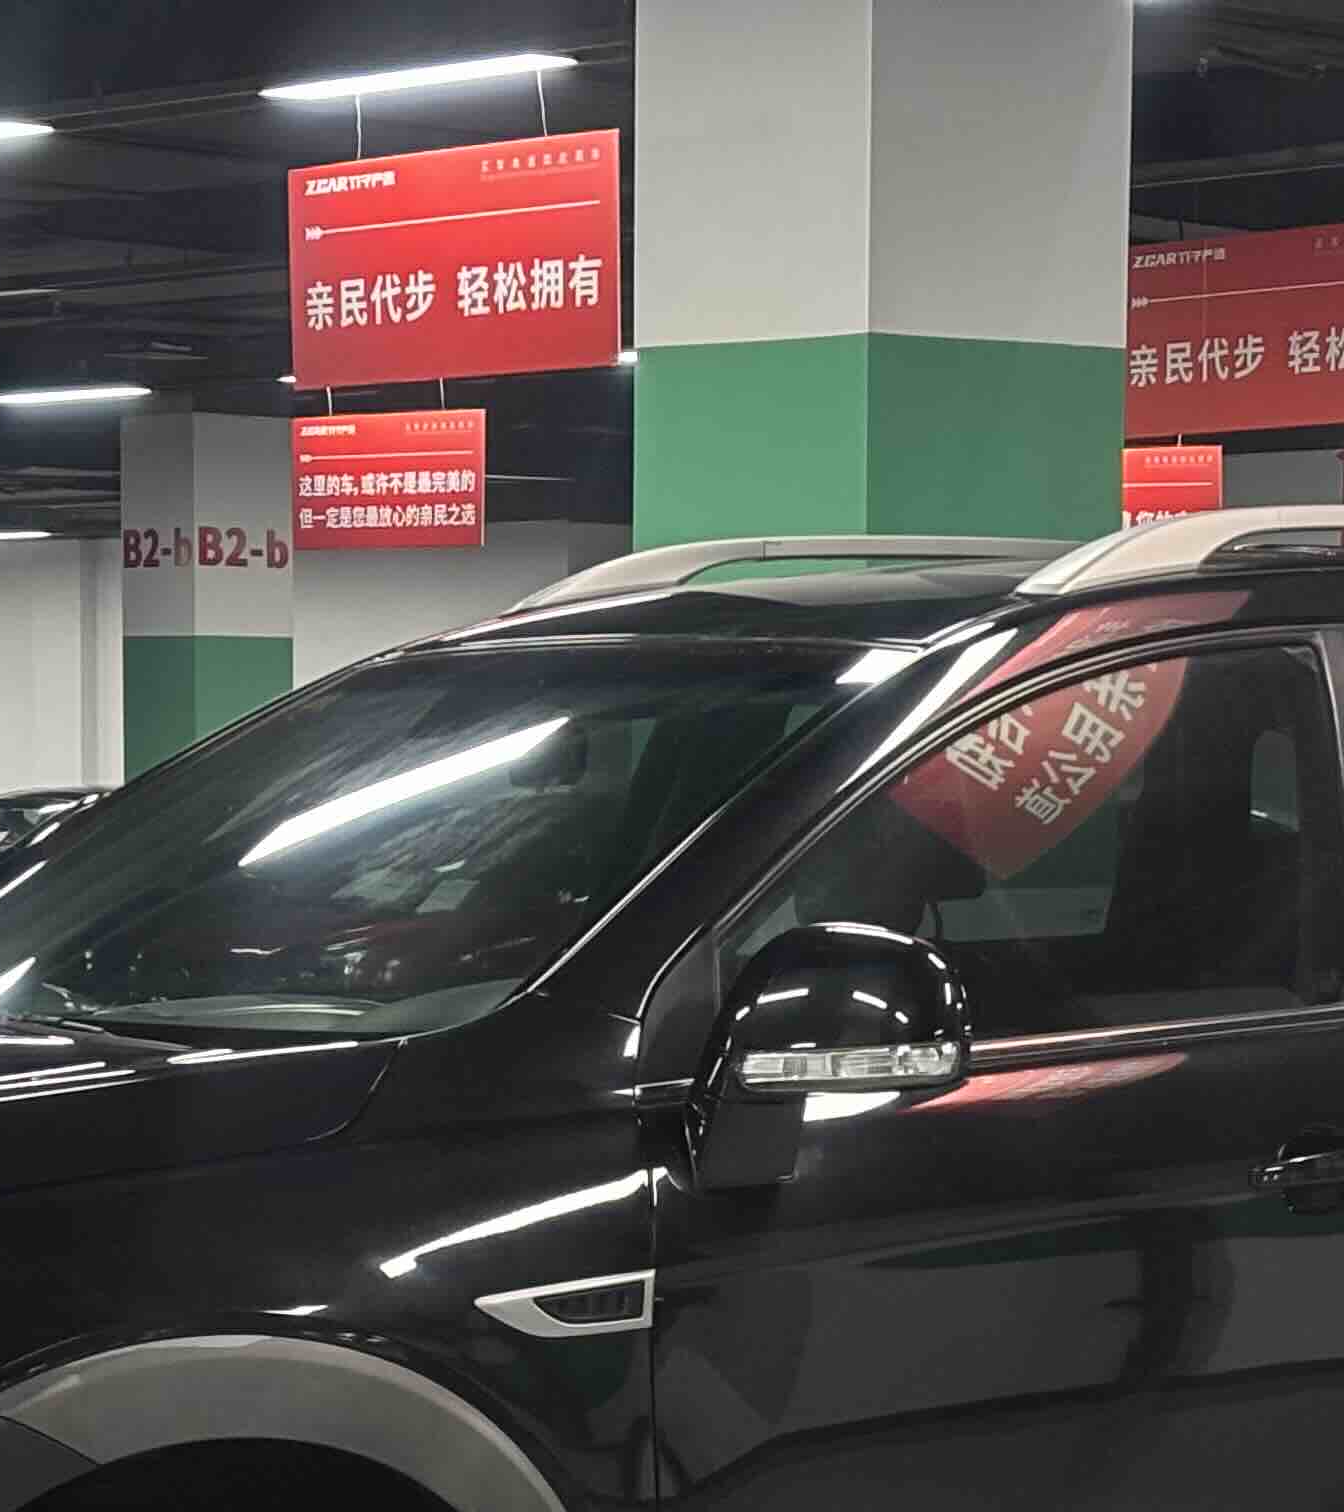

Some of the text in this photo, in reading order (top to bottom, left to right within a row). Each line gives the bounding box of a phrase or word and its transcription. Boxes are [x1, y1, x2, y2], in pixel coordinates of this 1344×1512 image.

[1132, 252, 1176, 269] ZCAR
[305, 253, 602, 331] 亲民代步 轻松拥有
[1128, 333, 1264, 387] 亲民代步
[299, 503, 476, 529] 但一定是您最放心的亲民之选
[123, 527, 193, 568] B2-b
[197, 526, 289, 569] B2-b
